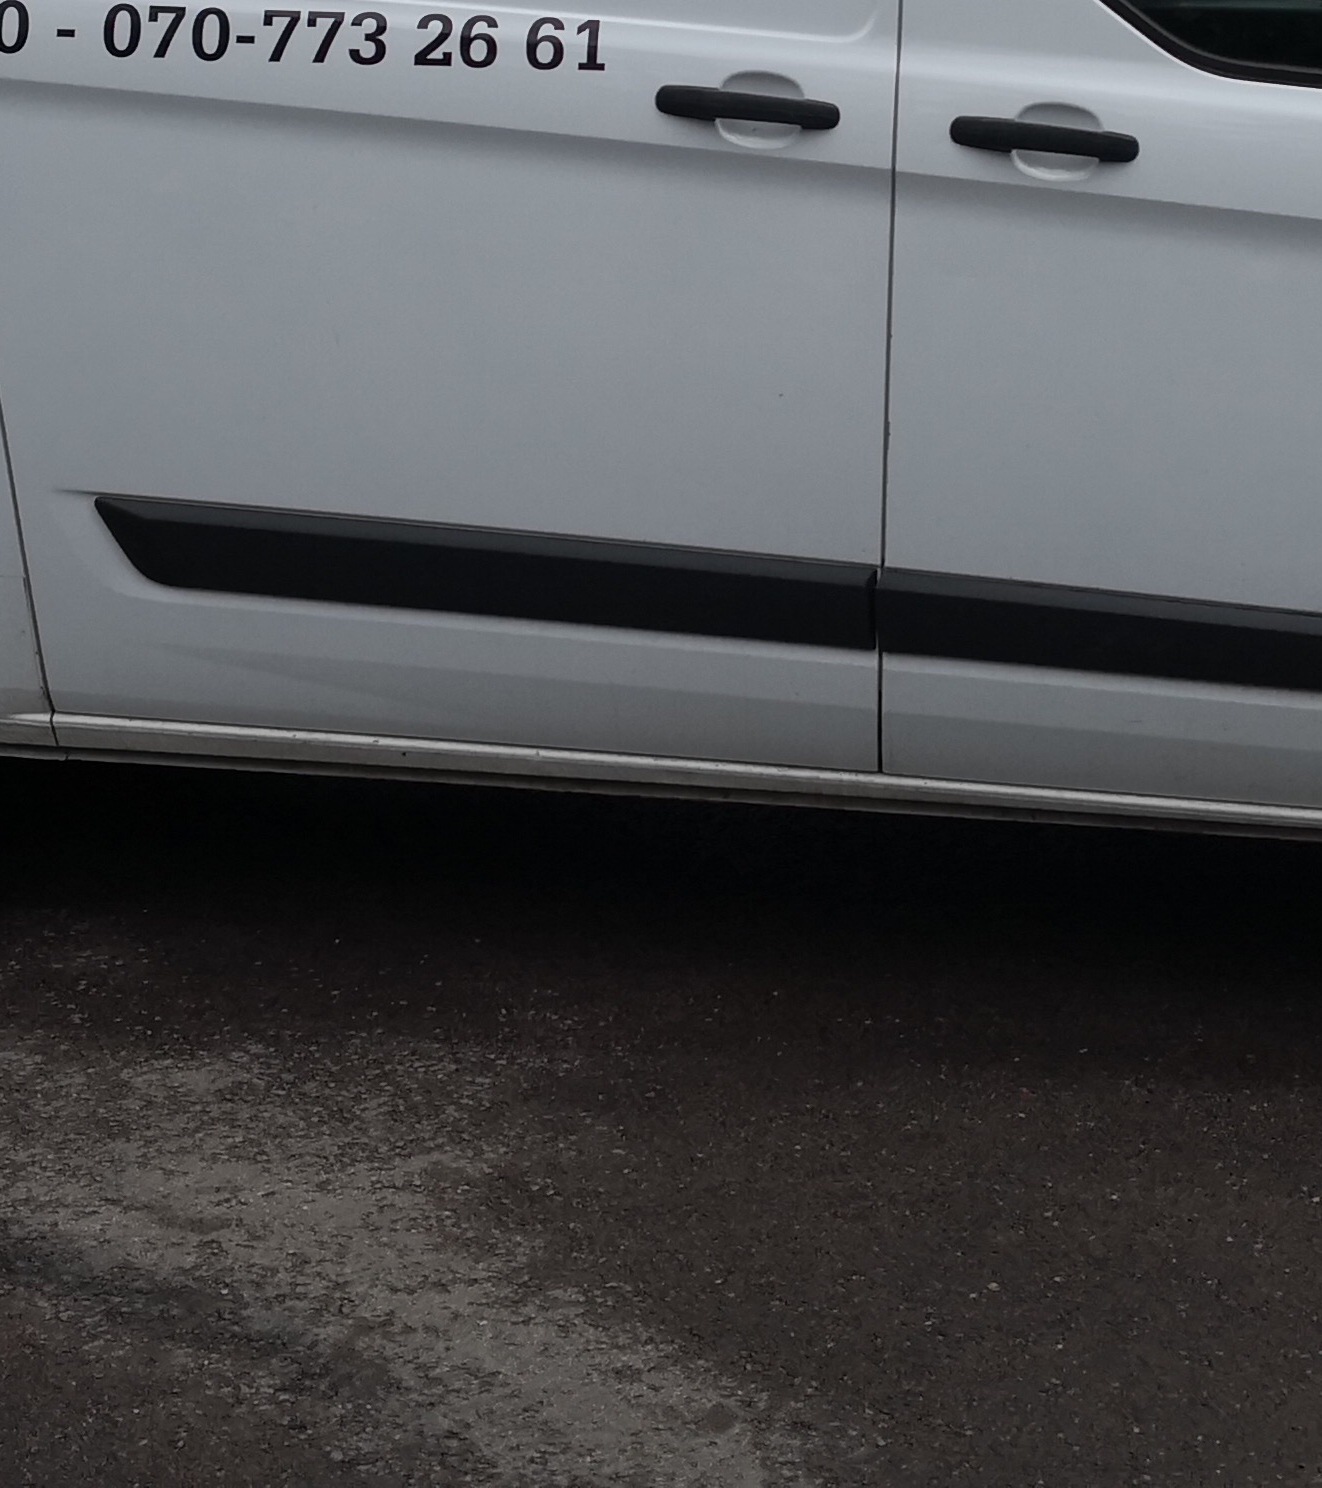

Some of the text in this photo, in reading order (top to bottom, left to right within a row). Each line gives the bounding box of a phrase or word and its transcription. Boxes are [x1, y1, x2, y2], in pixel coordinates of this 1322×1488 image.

[103, 3, 388, 66] 070-773
[413, 13, 499, 69] 26
[526, 16, 606, 72] 61
